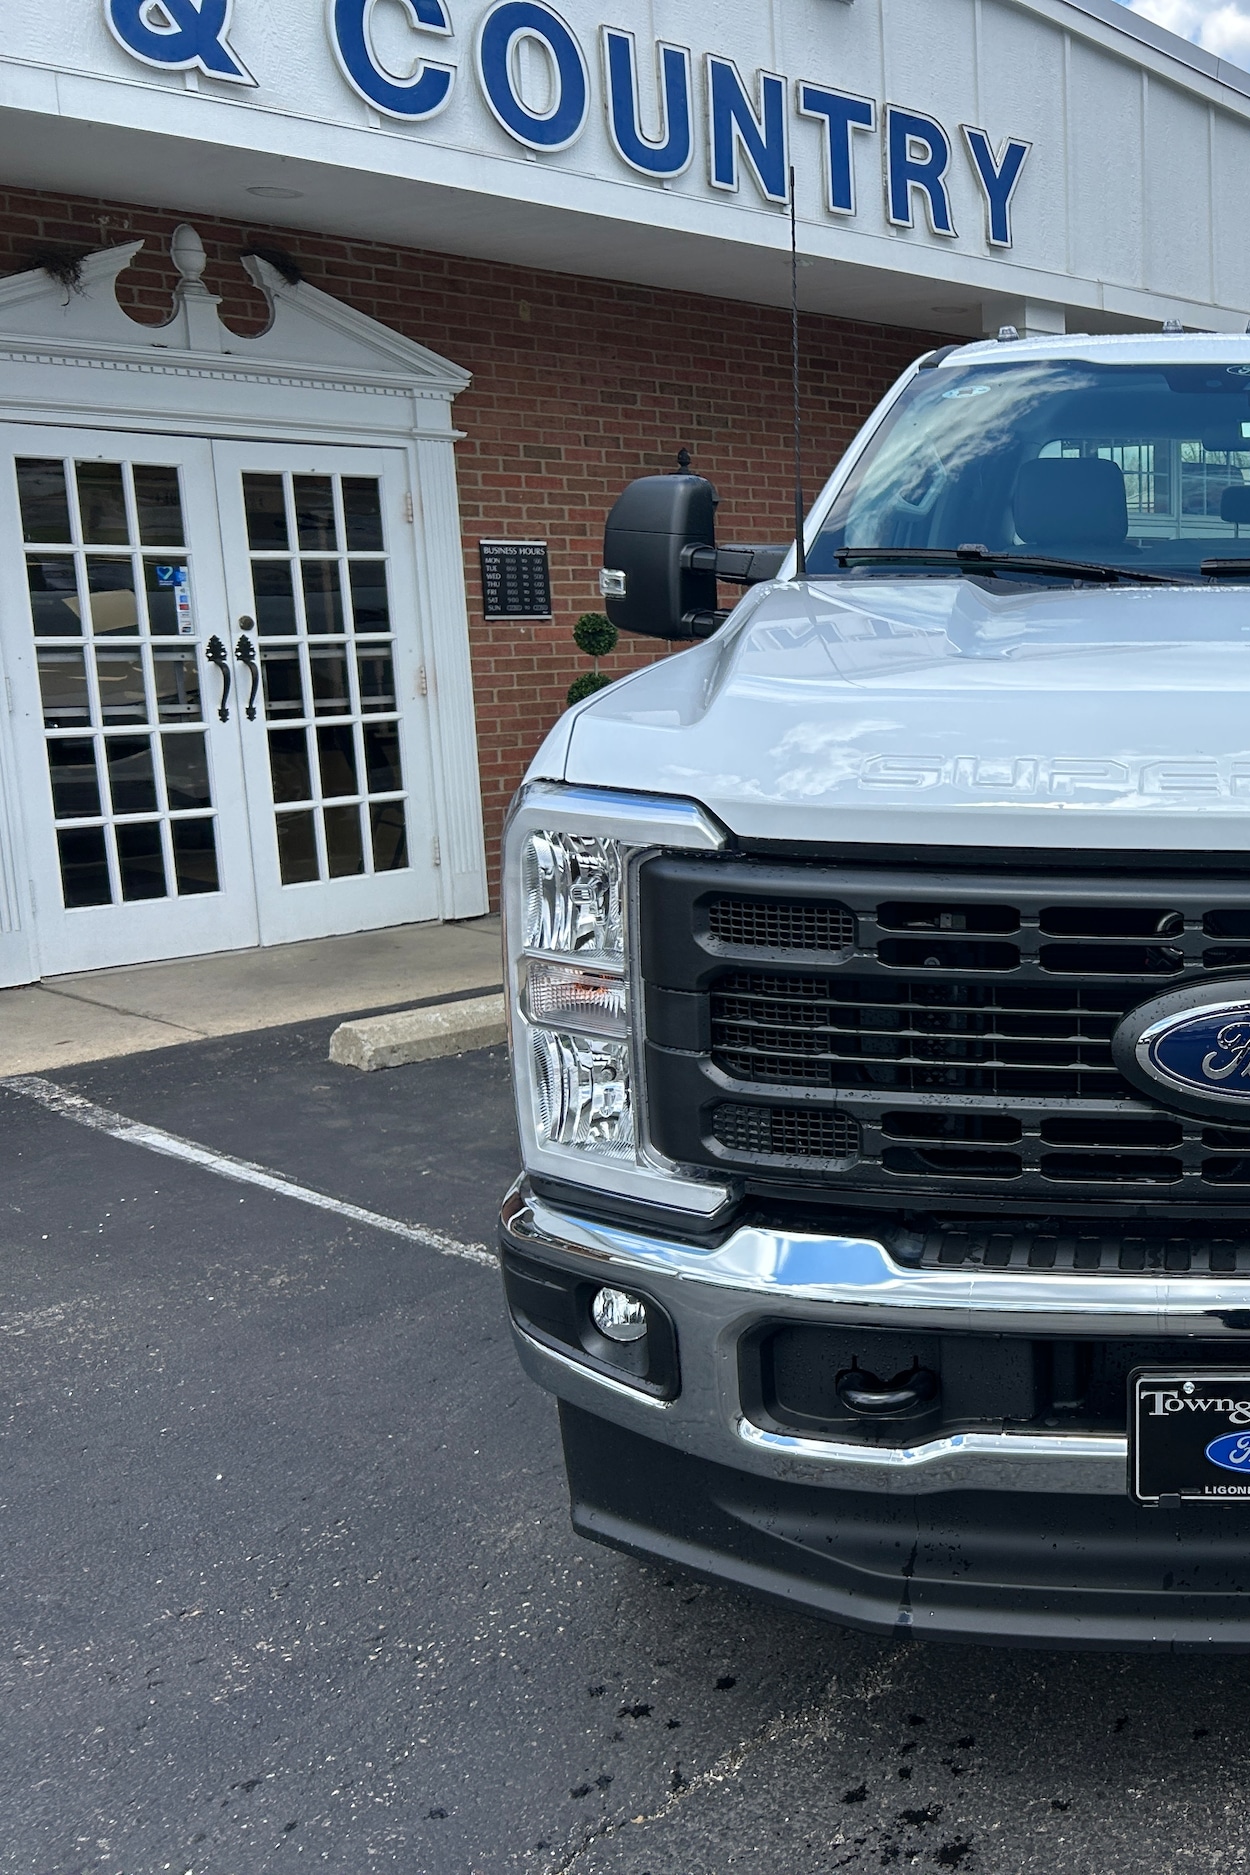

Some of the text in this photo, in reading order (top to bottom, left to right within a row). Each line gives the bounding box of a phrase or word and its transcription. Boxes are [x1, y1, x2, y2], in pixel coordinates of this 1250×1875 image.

[327, 0, 1034, 249] COUNTRY
[483, 546, 546, 556] BUSINESS HOURS
[1140, 1391, 1236, 1416] Town
